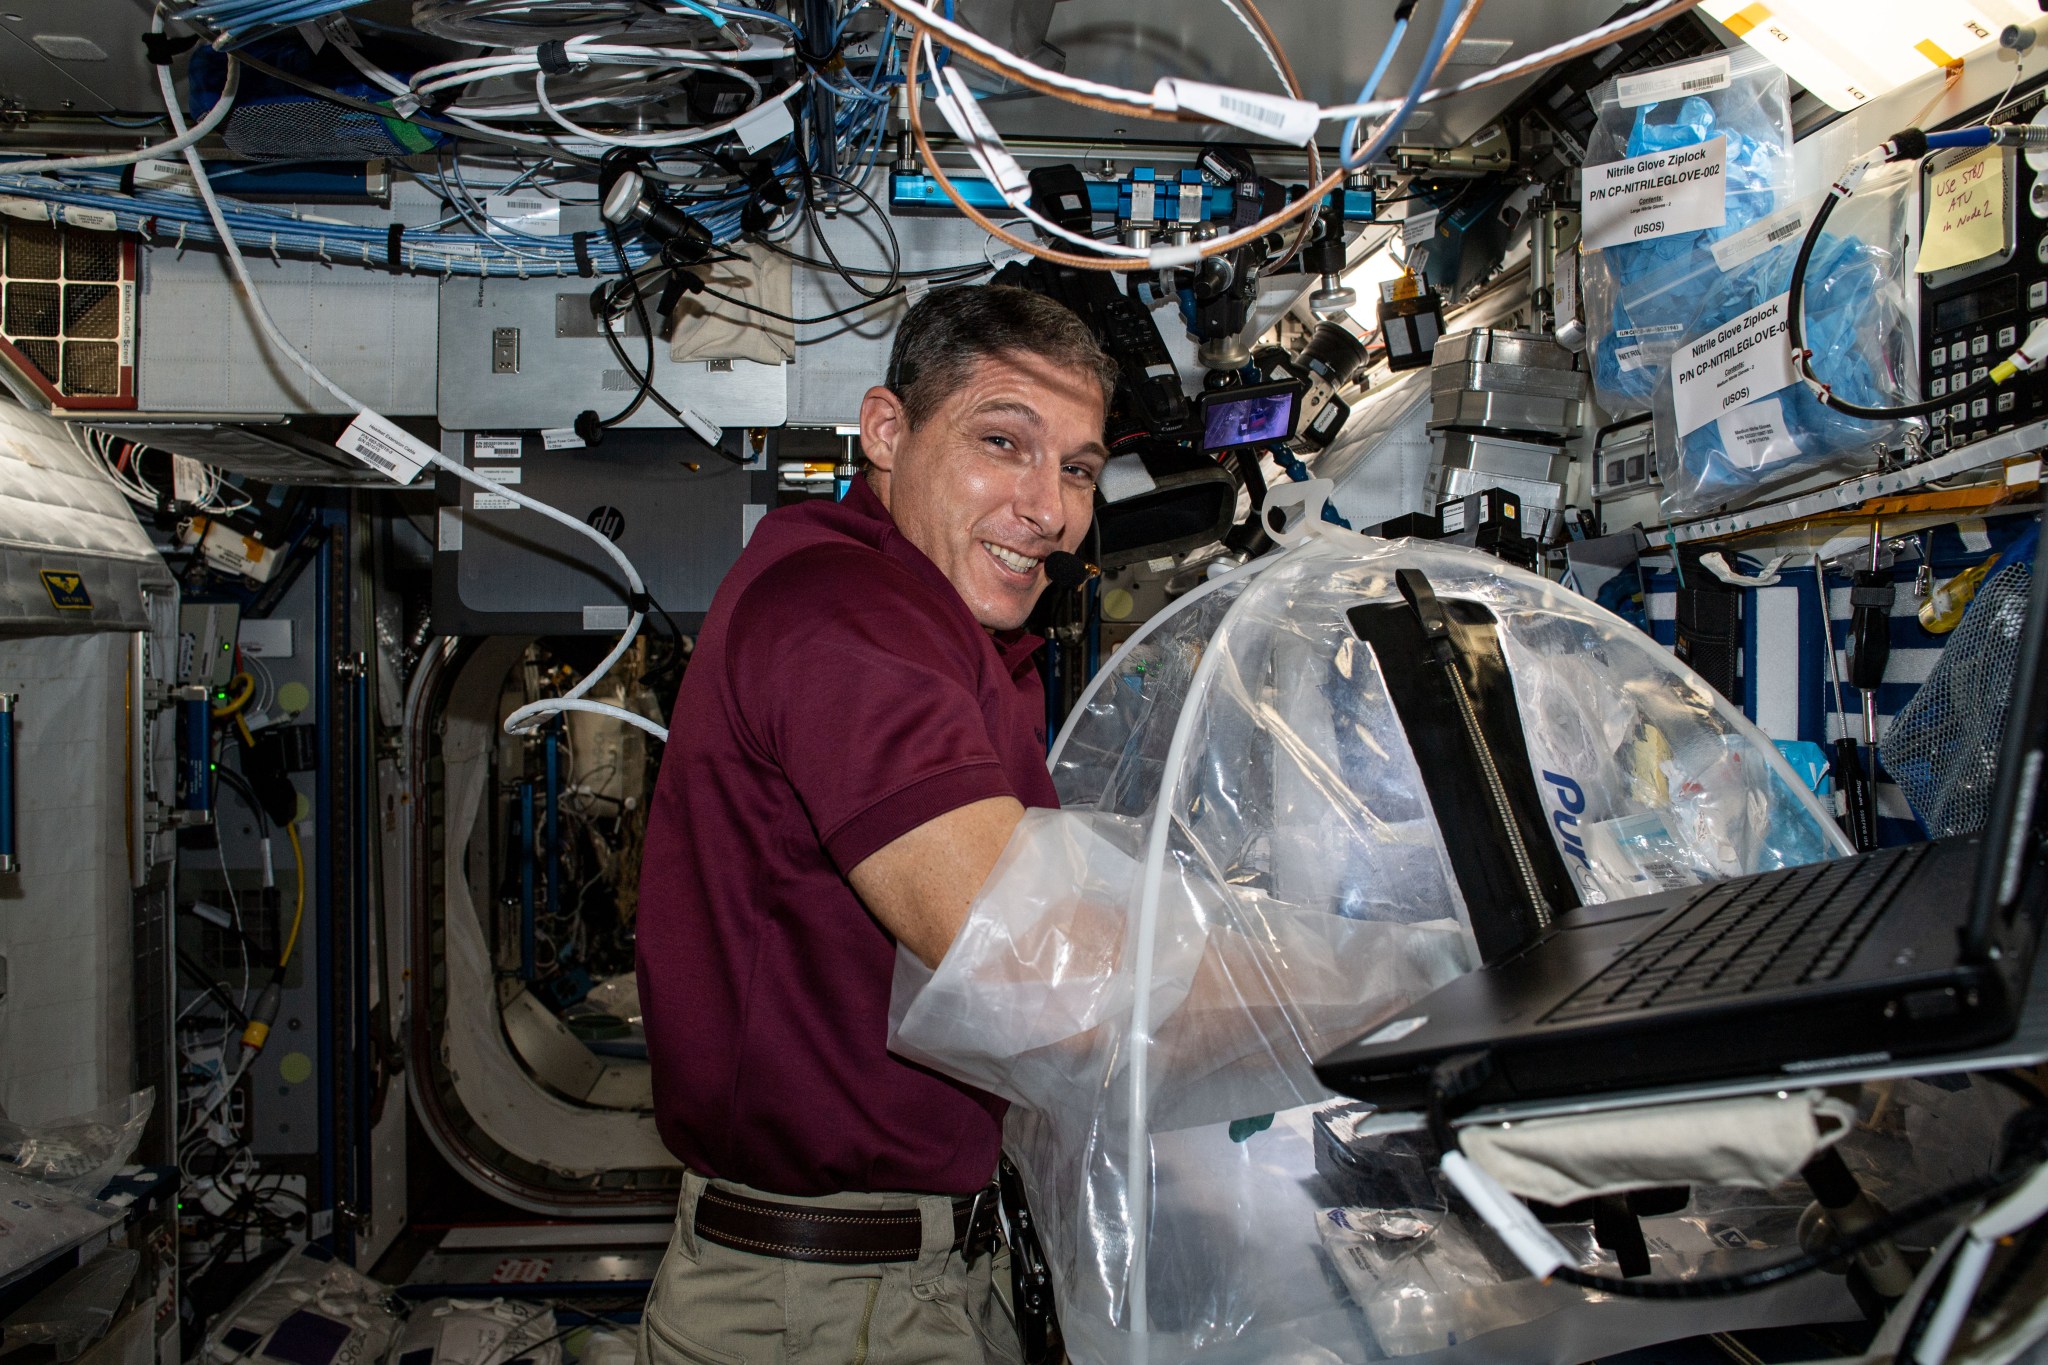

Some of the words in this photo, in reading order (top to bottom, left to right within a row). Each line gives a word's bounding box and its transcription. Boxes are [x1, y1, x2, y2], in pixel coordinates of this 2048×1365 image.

[1769, 26, 1789, 42] D2
[1966, 21, 1989, 39] D4
[1848, 87, 1866, 100] D1
[2022, 96, 2040, 112] UNIT
[1607, 163, 1634, 179] Nitrile
[1637, 158, 1665, 172] Glove
[1668, 149, 1706, 167] Ziplock
[1590, 188, 1606, 201] P/N
[1608, 164, 1720, 197] CP-NITRILEGLOVE-002
[1639, 195, 1663, 205] Contents:
[1948, 190, 1973, 213] ATU
[1634, 221, 1665, 237] (USOS)
[1956, 209, 1981, 229] Node
[124, 284, 132, 313] Exhaust
[1692, 339, 1716, 358] Nitrile
[1717, 326, 1741, 343] Glove
[1743, 304, 1778, 329] Ziplock
[1618, 349, 1641, 360] NITRIL
[1679, 370, 1695, 384] P/N
[1696, 319, 1790, 376] CP-NITRILEGLOVE-00
[1724, 361, 1745, 377] Contents:
[1722, 387, 1750, 409] (USOS)
[1161, 424, 1183, 432] Canon
[369, 424, 386, 436] Headset
[385, 434, 404, 448] Extension
[404, 445, 416, 455] Cable
[591, 505, 621, 540] hp
